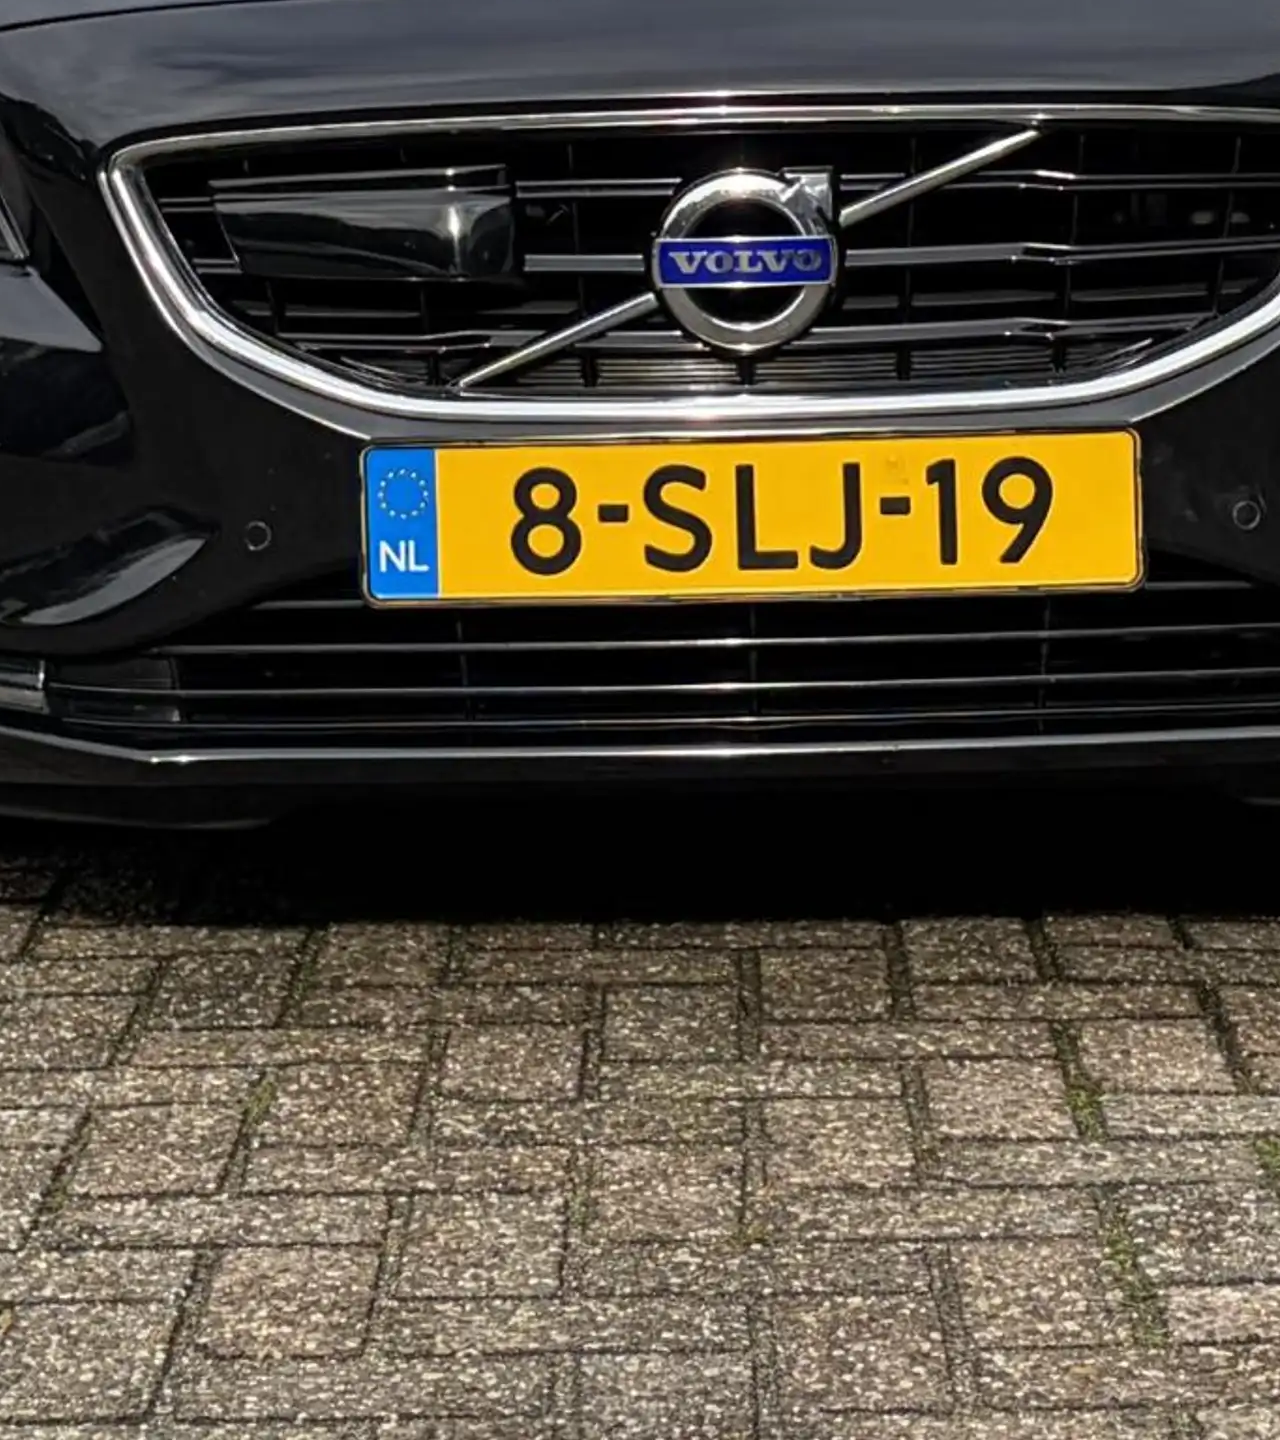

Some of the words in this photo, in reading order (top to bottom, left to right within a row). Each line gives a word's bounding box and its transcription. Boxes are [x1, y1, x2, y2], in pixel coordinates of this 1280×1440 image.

[668, 249, 822, 275] VOLVO
[510, 456, 1054, 576] 8-SLJ-19
[378, 541, 429, 572] NL
